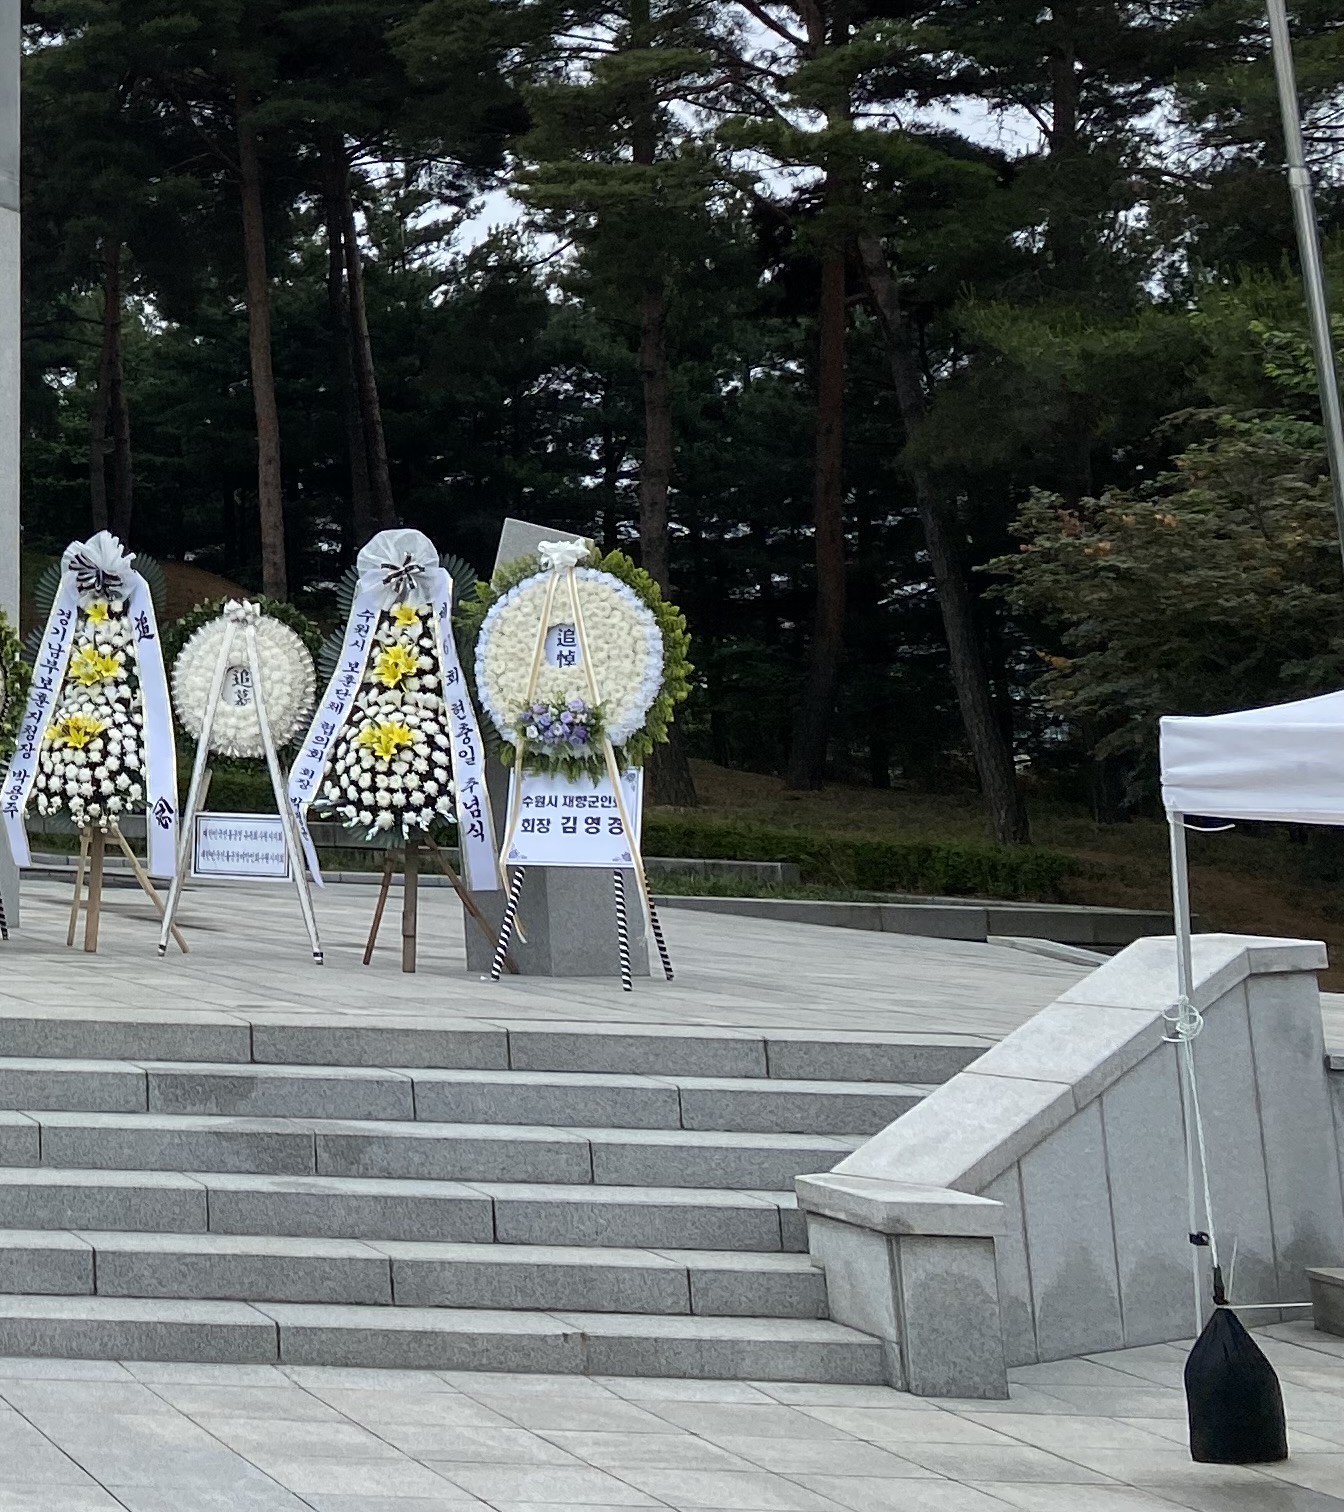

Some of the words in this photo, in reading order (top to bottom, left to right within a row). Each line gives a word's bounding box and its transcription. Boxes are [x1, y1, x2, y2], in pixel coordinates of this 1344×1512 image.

[349, 609, 375, 651] 수원시
[556, 628, 577, 668] 追悼
[20, 609, 71, 759] 경기남부보훈지청장
[327, 661, 359, 715] 보훈단체
[306, 721, 335, 762] 협의회
[451, 699, 476, 766] 현충일
[3, 769, 30, 819] 박용주
[296, 768, 315, 790] 회장
[461, 777, 485, 843] 추념식
[522, 795, 558, 808] 수원시
[521, 817, 551, 834] 회장
